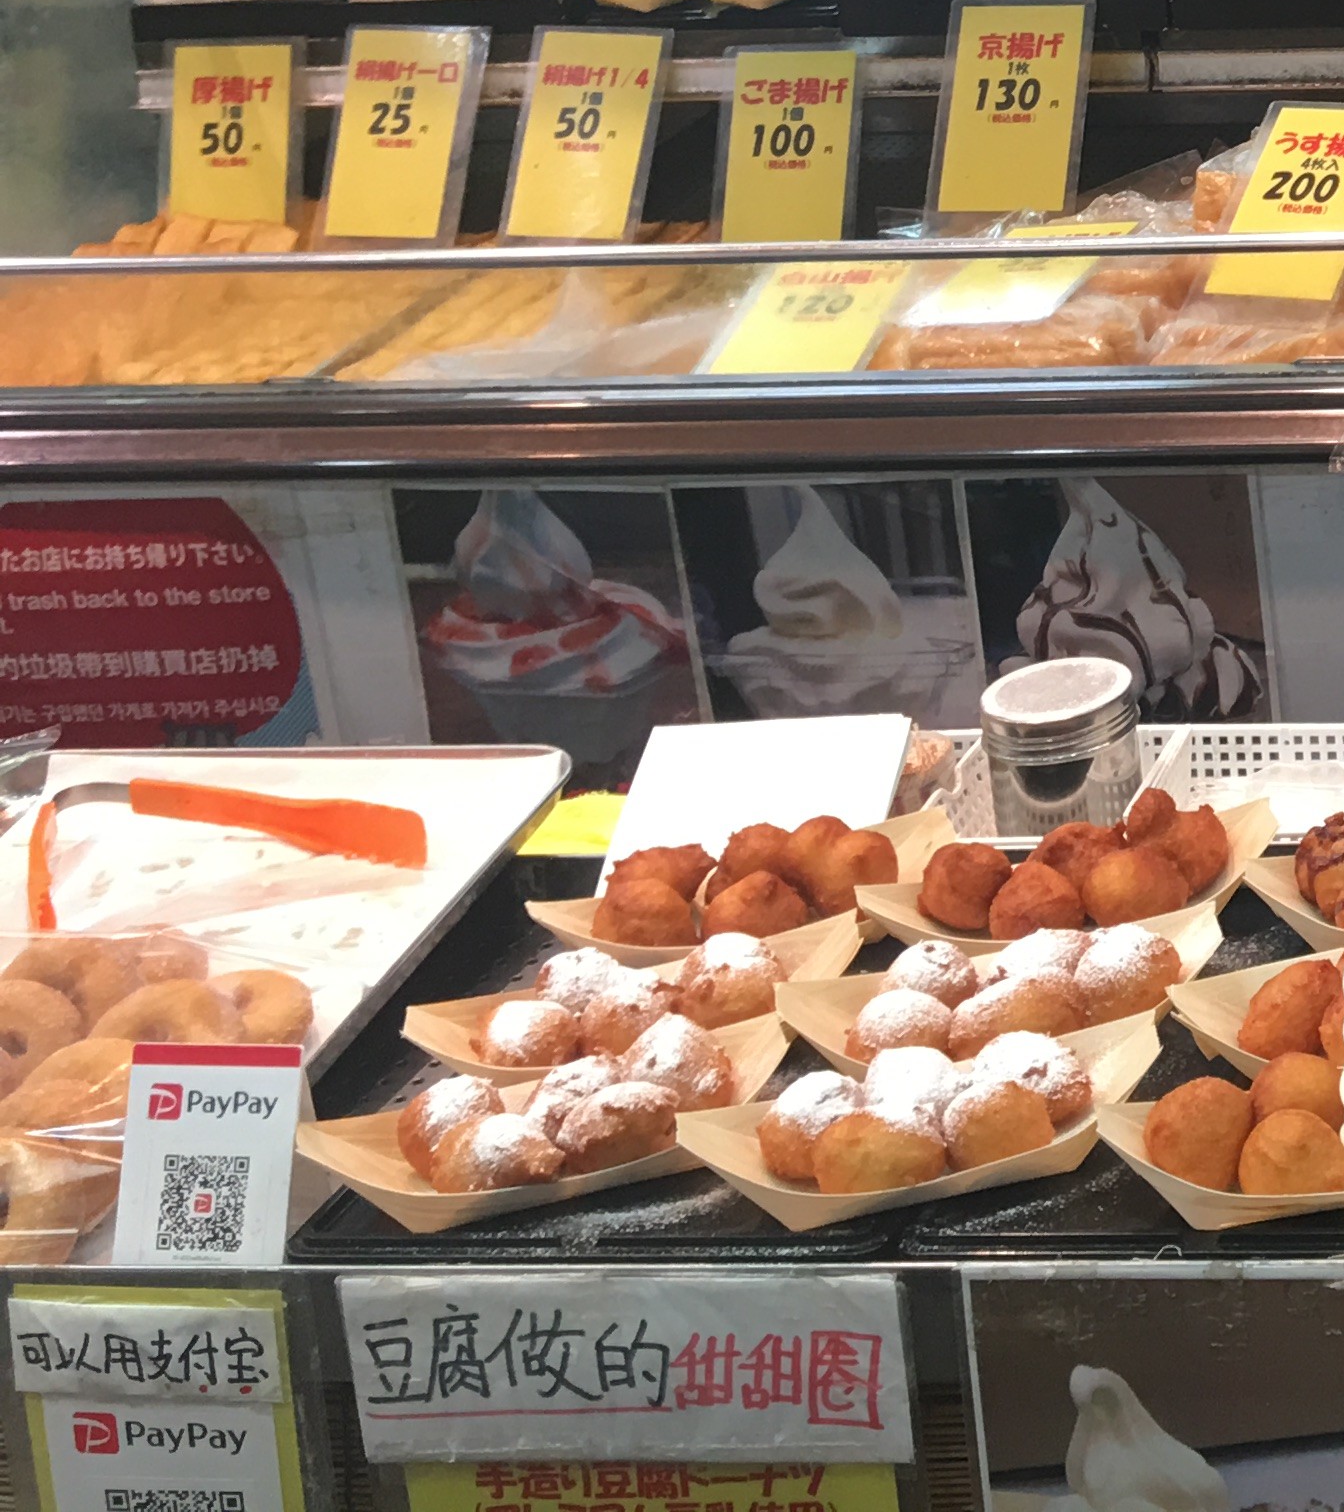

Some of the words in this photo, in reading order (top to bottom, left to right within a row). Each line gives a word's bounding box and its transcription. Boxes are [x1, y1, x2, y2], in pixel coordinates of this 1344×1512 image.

[977, 32, 1065, 61] 京揚げ
[1007, 62, 1030, 76] 1枚
[190, 76, 273, 104] 厚揚げ
[740, 77, 850, 107] ごま揚げ
[976, 78, 1042, 112] 130
[367, 102, 413, 136] 25
[552, 106, 602, 141] 50
[782, 107, 804, 122] 1個
[199, 122, 245, 157] 50
[751, 124, 816, 158] 100
[1300, 158, 1340, 173] 4枚入
[1262, 170, 1341, 204] 200
[7, 590, 69, 611] trash
[73, 589, 130, 608] back
[134, 589, 159, 608] to
[164, 587, 202, 606] the
[208, 585, 272, 605] store
[186, 1089, 279, 1121] PayPay
[16, 1327, 270, 1386] 可以用支付宝
[364, 1303, 885, 1430] 豆腐做的甜甜圈
[125, 1421, 248, 1456] PayPay
